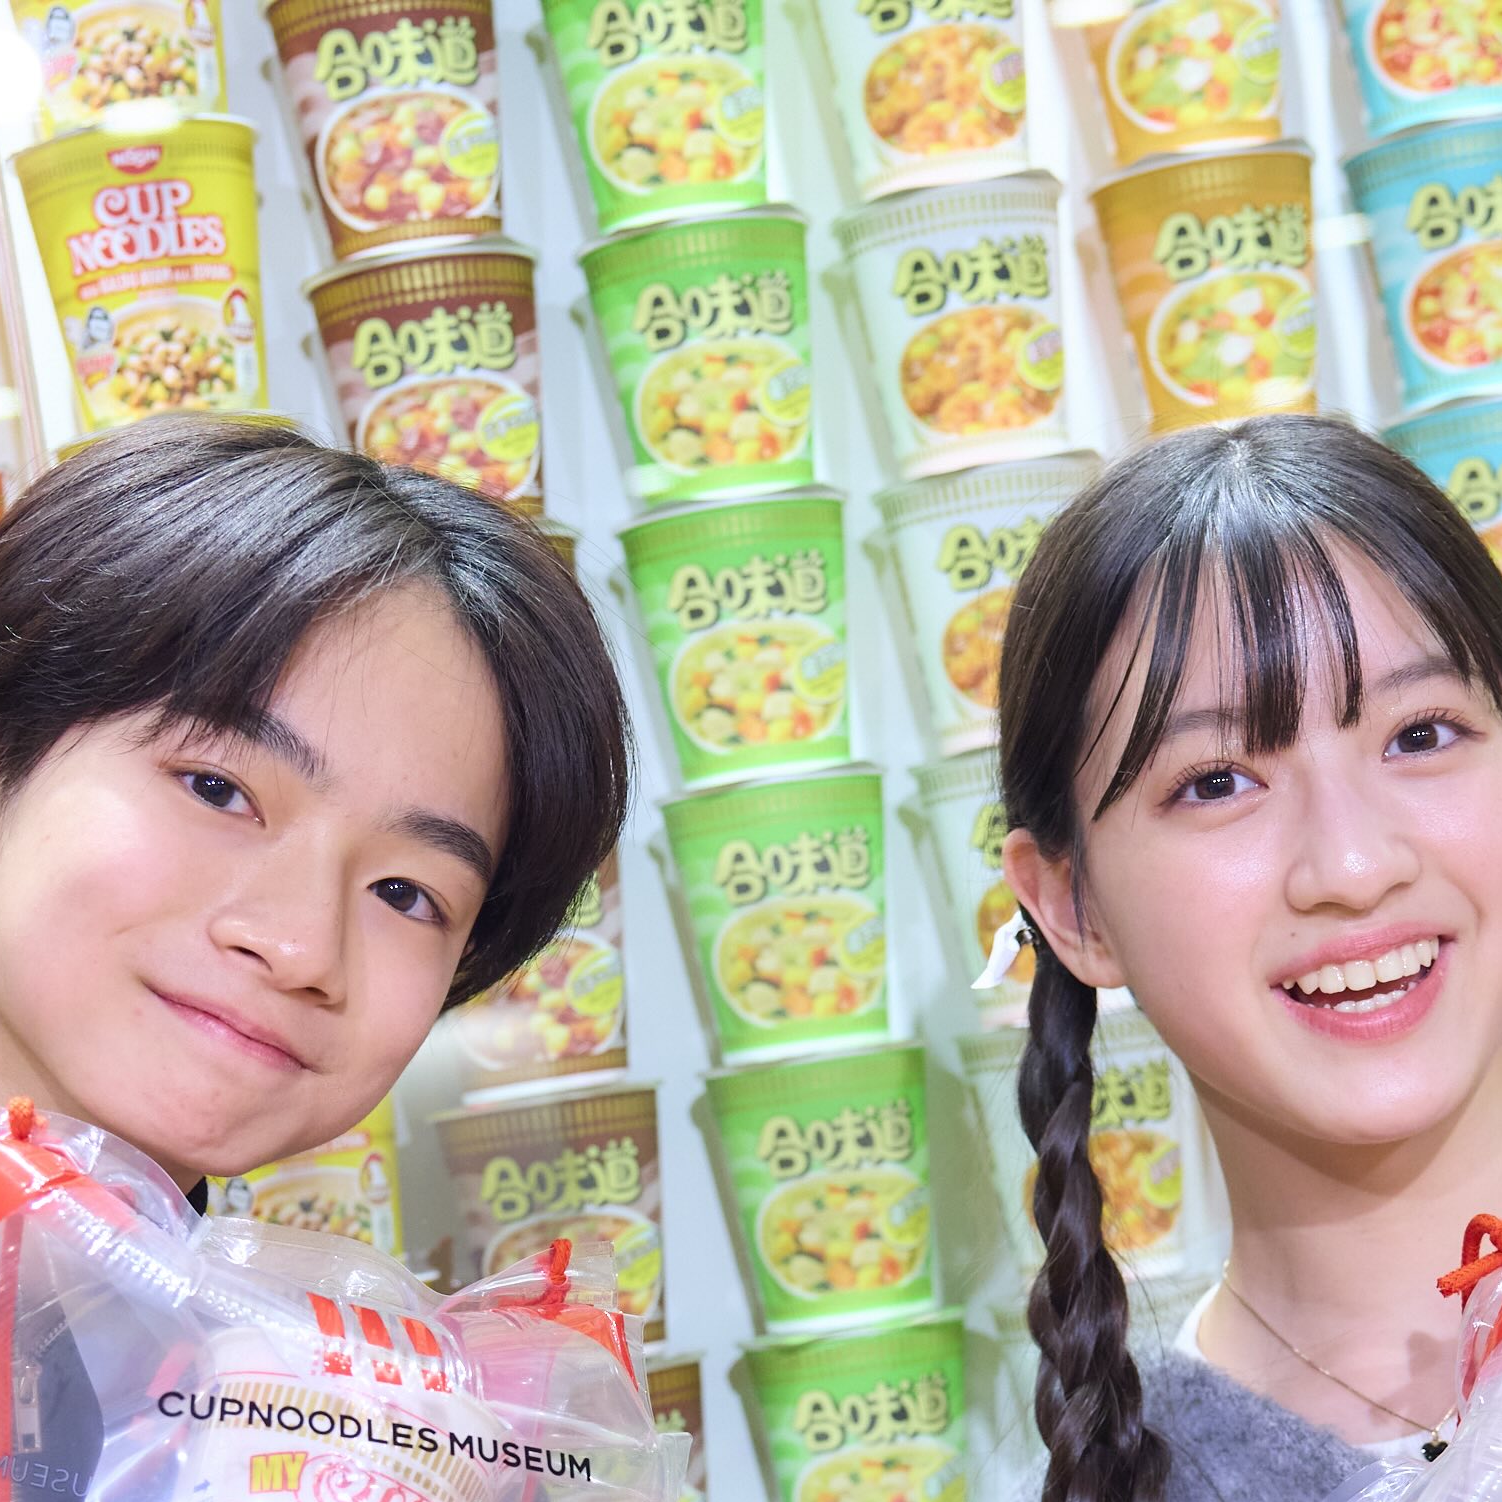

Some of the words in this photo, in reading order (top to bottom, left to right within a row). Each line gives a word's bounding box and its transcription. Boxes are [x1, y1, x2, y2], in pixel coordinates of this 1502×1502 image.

[94, 180, 192, 226] CUP
[67, 215, 226, 277] NOODLES
[158, 1391, 438, 1453] CUPNOODLES
[449, 1431, 592, 1483] MUSEUM
[250, 1451, 308, 1493] MY
